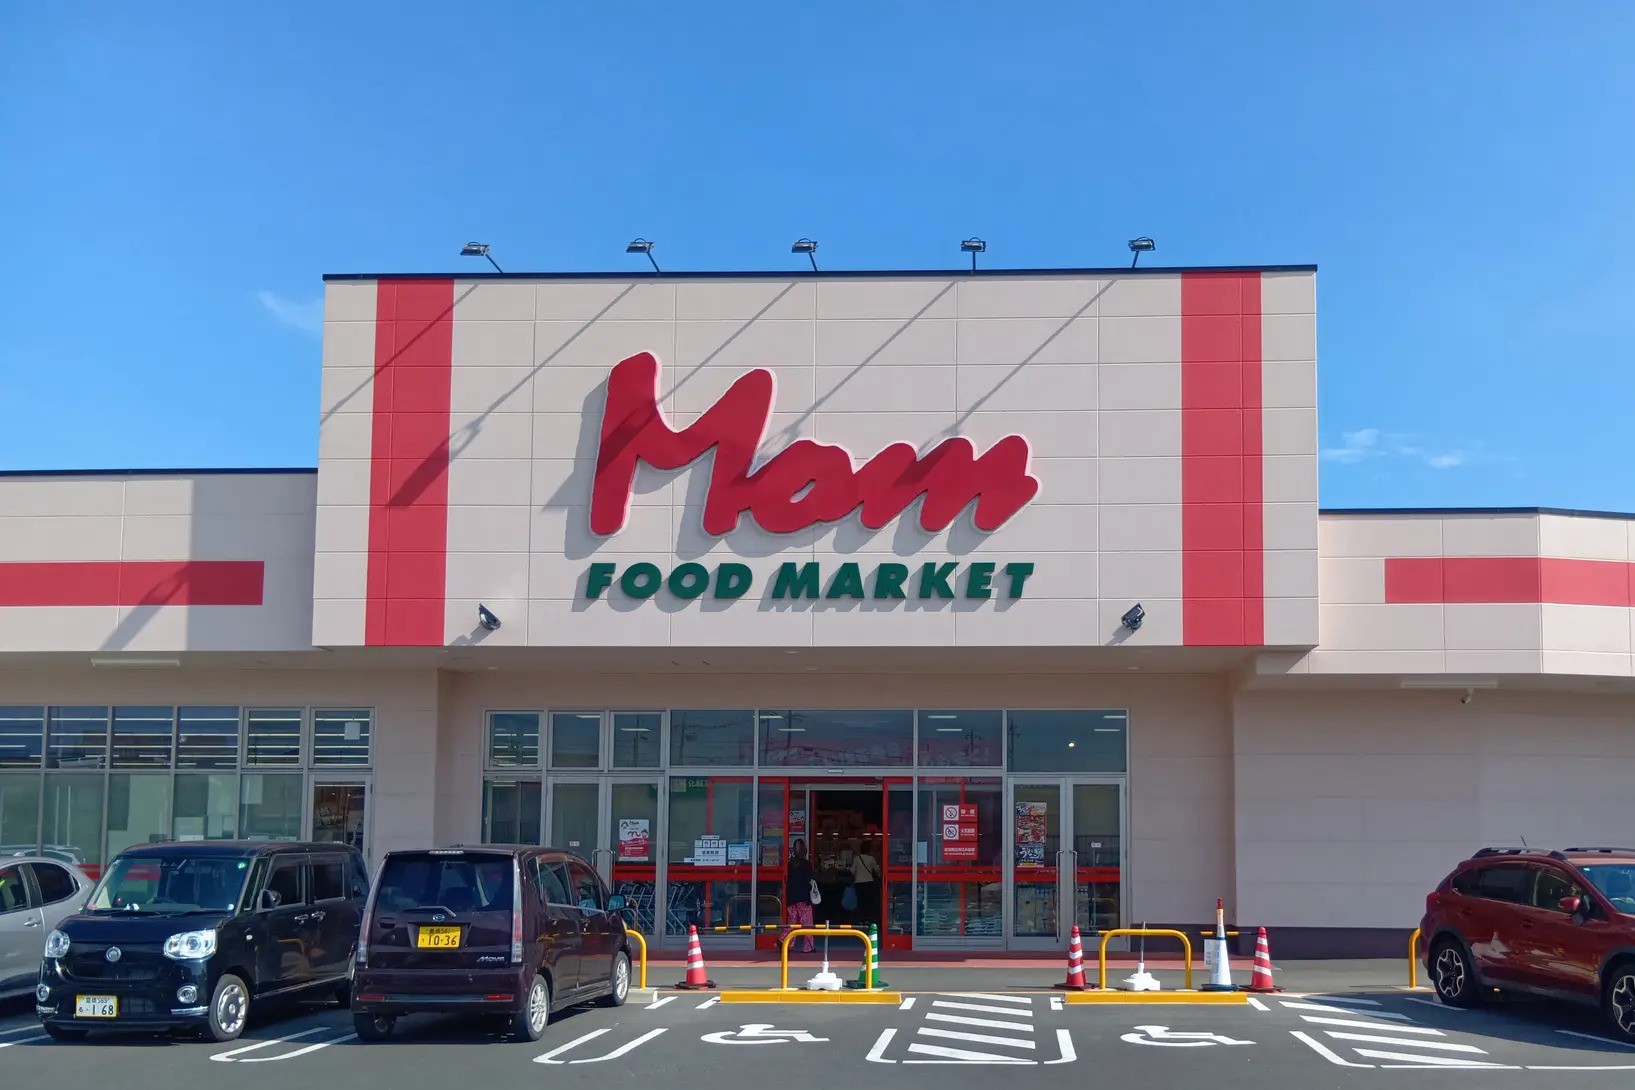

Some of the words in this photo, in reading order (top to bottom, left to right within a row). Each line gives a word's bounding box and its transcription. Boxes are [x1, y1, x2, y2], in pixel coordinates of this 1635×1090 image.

[588, 351, 1040, 536] Mom
[586, 562, 753, 599] FOOD
[771, 562, 1035, 599] MARKET
